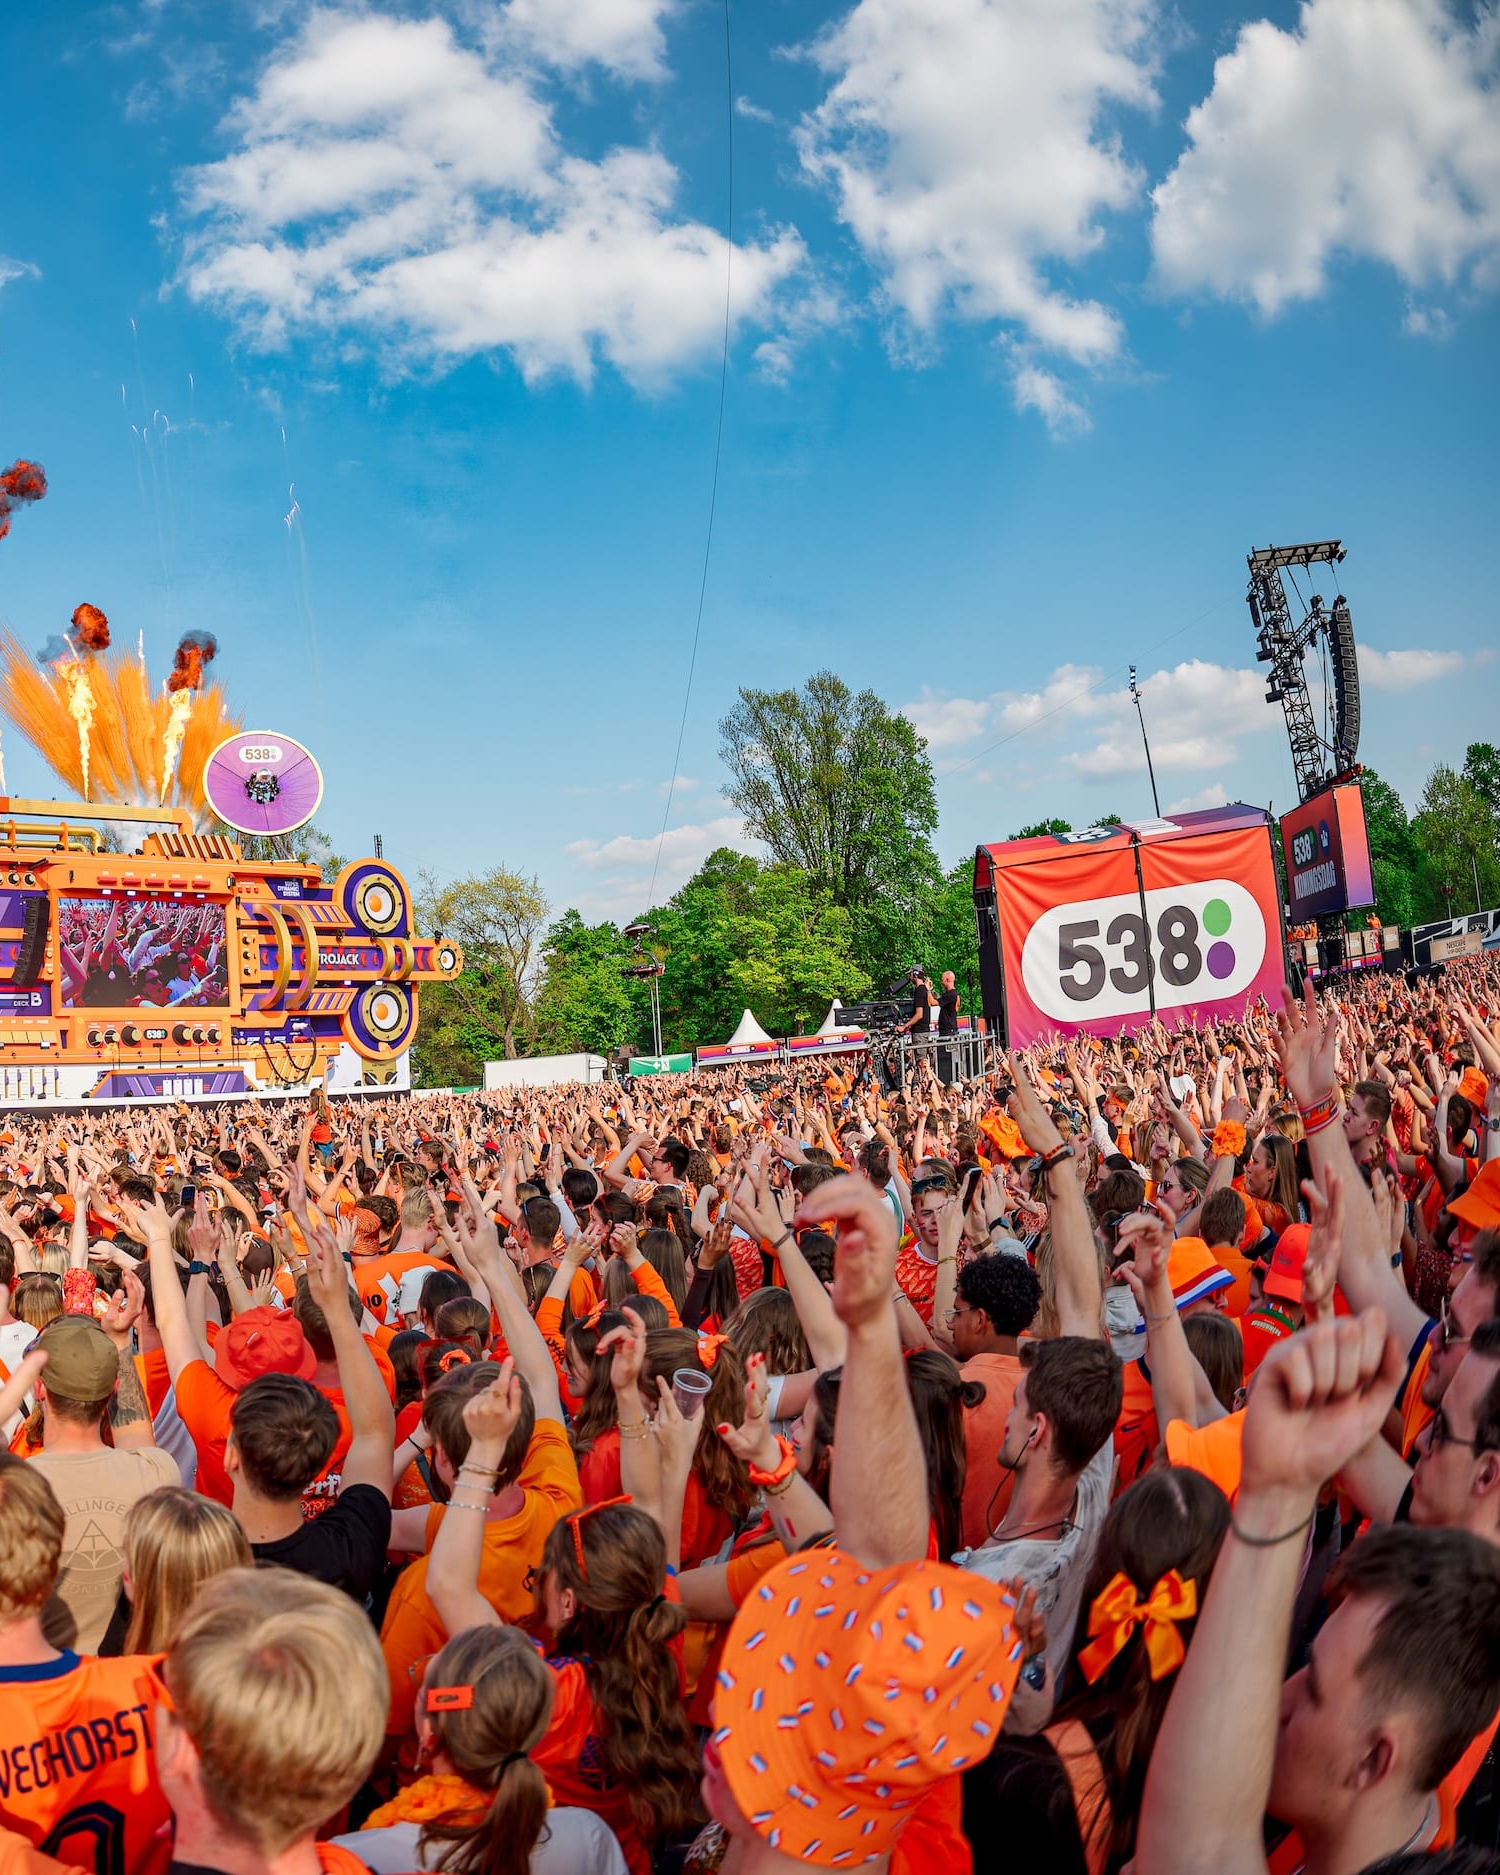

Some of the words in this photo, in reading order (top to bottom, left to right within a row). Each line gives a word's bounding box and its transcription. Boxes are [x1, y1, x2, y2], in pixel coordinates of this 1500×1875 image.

[244, 748, 270, 760] 538
[1293, 833, 1312, 865] 538
[1294, 860, 1337, 901] KONINGSDAG
[1058, 904, 1203, 1002] 538
[146, 1030, 161, 1039] 538
[366, 1294, 382, 1308] 10
